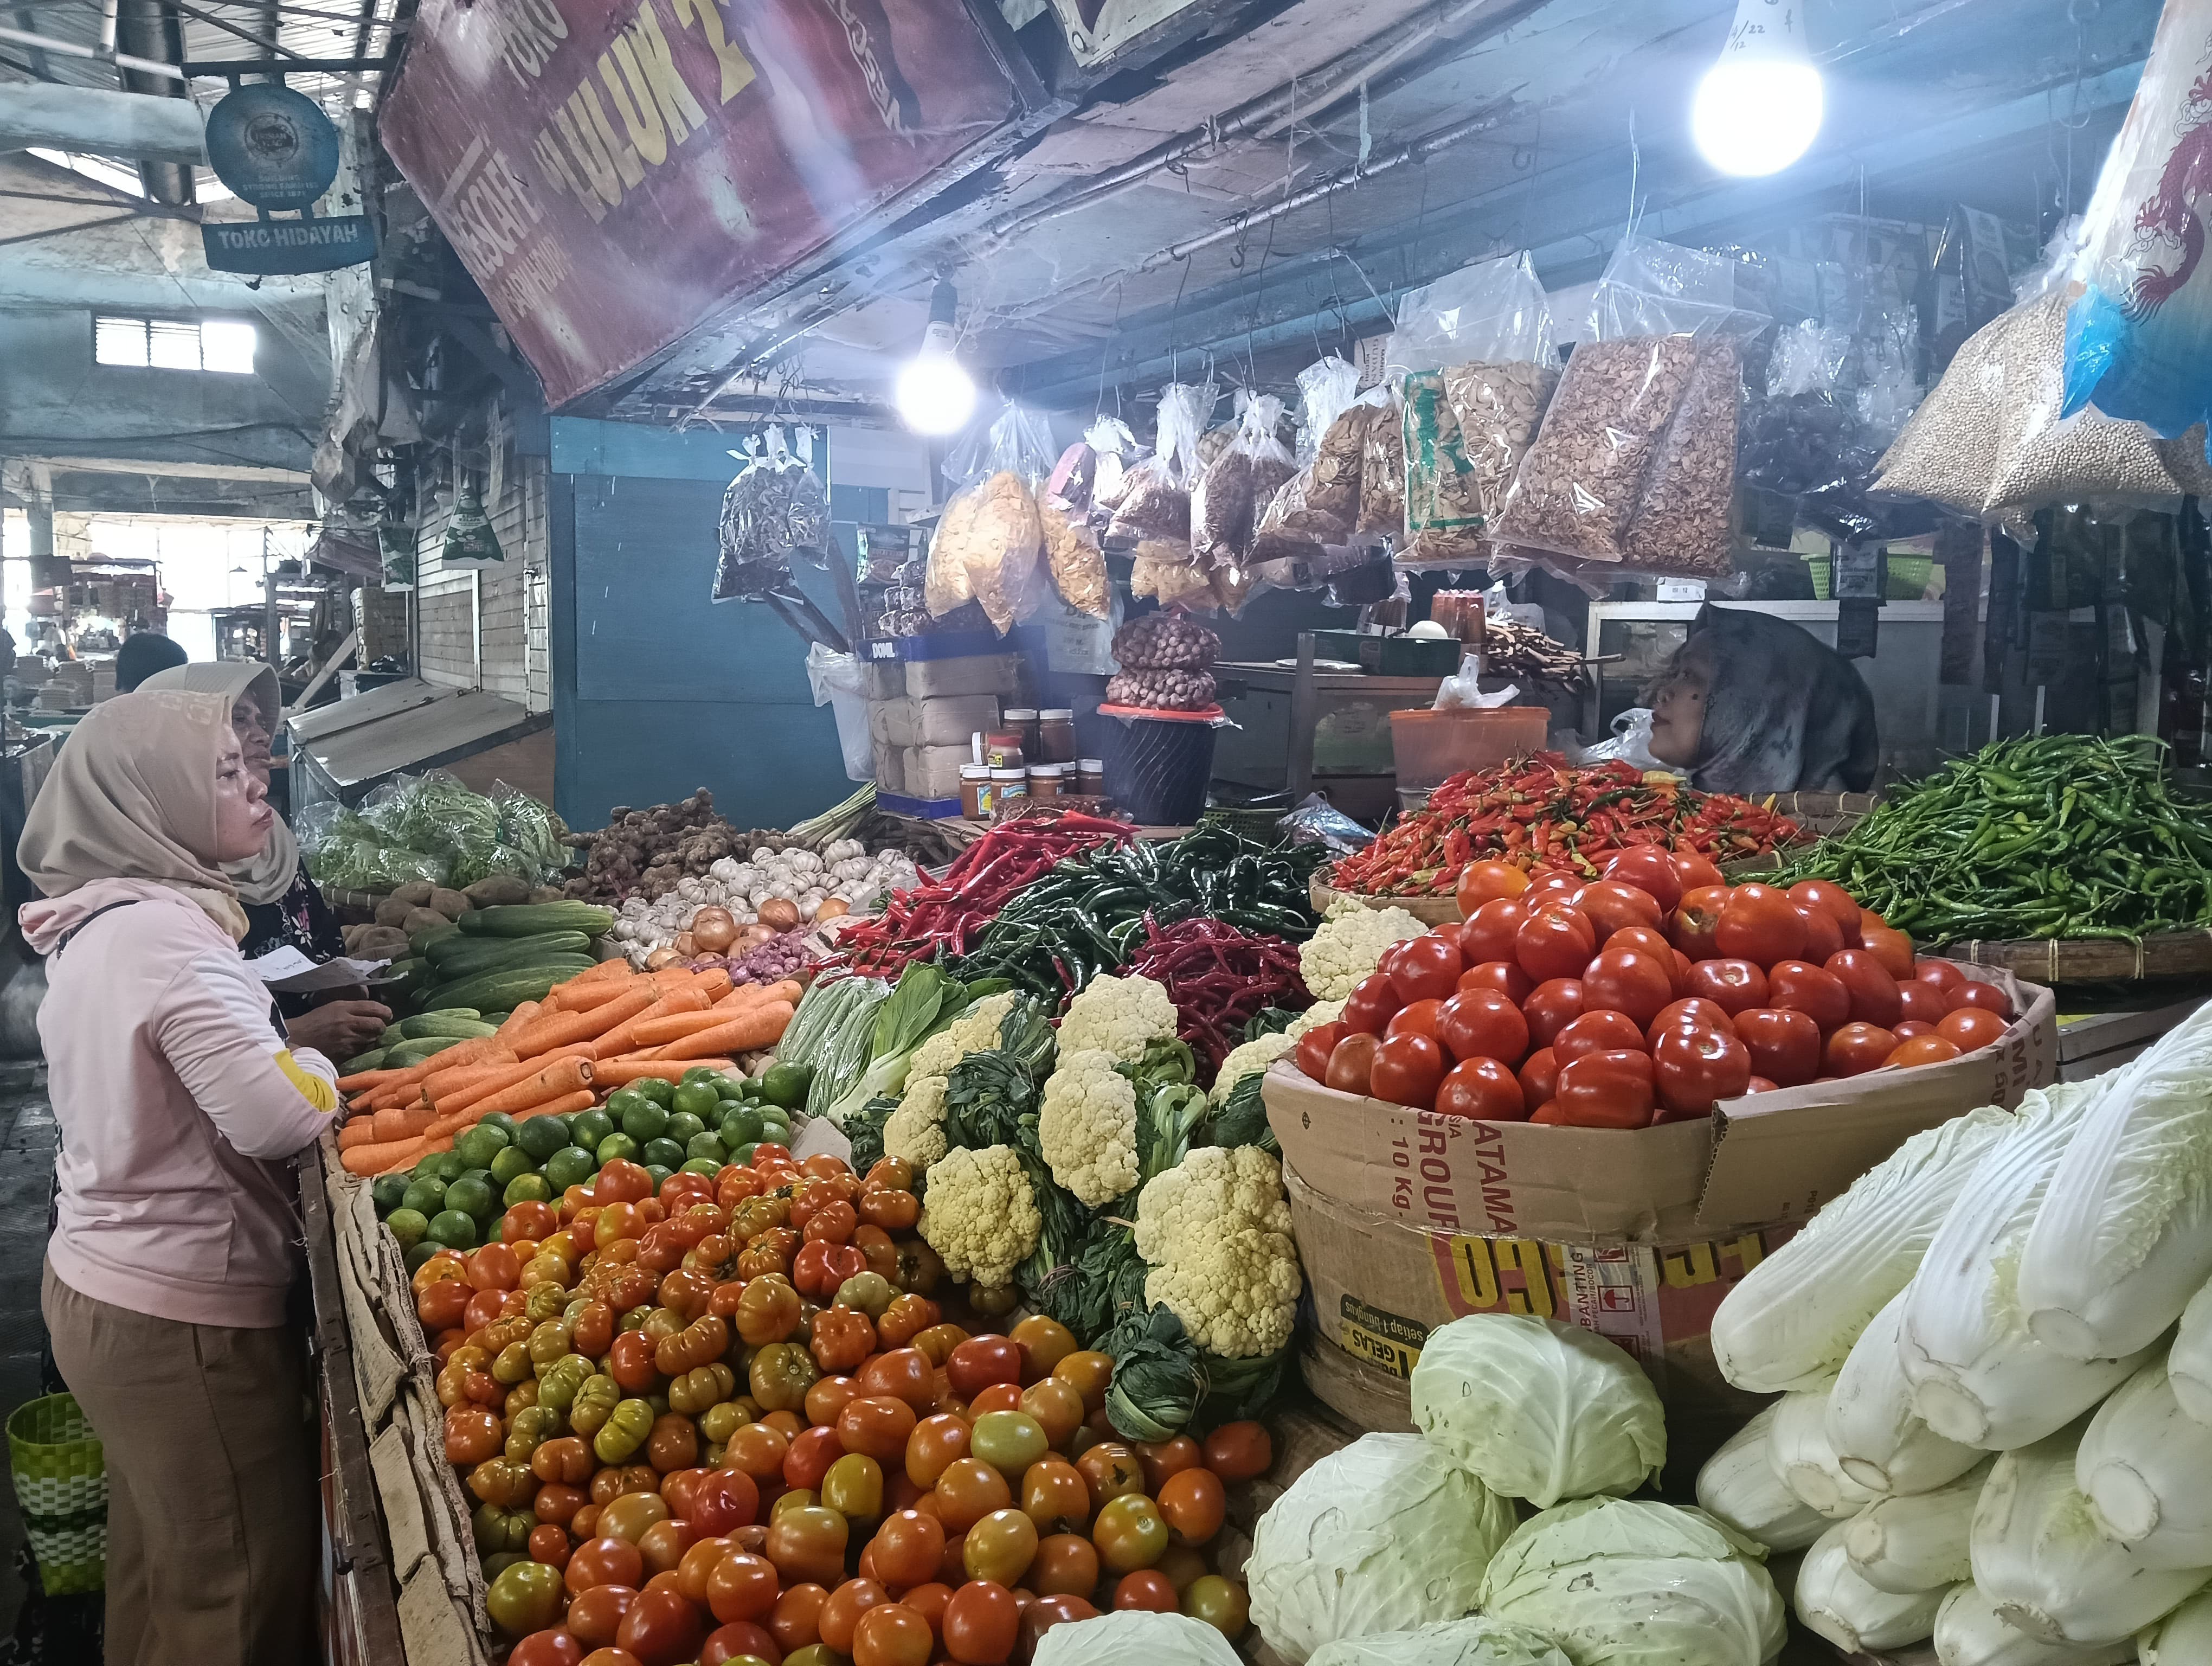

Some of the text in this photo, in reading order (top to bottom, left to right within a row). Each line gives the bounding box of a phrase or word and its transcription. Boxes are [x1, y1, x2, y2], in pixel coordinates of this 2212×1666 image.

[671, 0, 756, 106] 2
[217, 223, 358, 249] TOKO HIDAYAH
[1392, 1136, 1410, 1168] 10
[1572, 1252, 1592, 1332] BANTING
[1345, 1301, 1424, 1342] setiap 1 bungkus
[1352, 1329, 1396, 1363] GELAS
